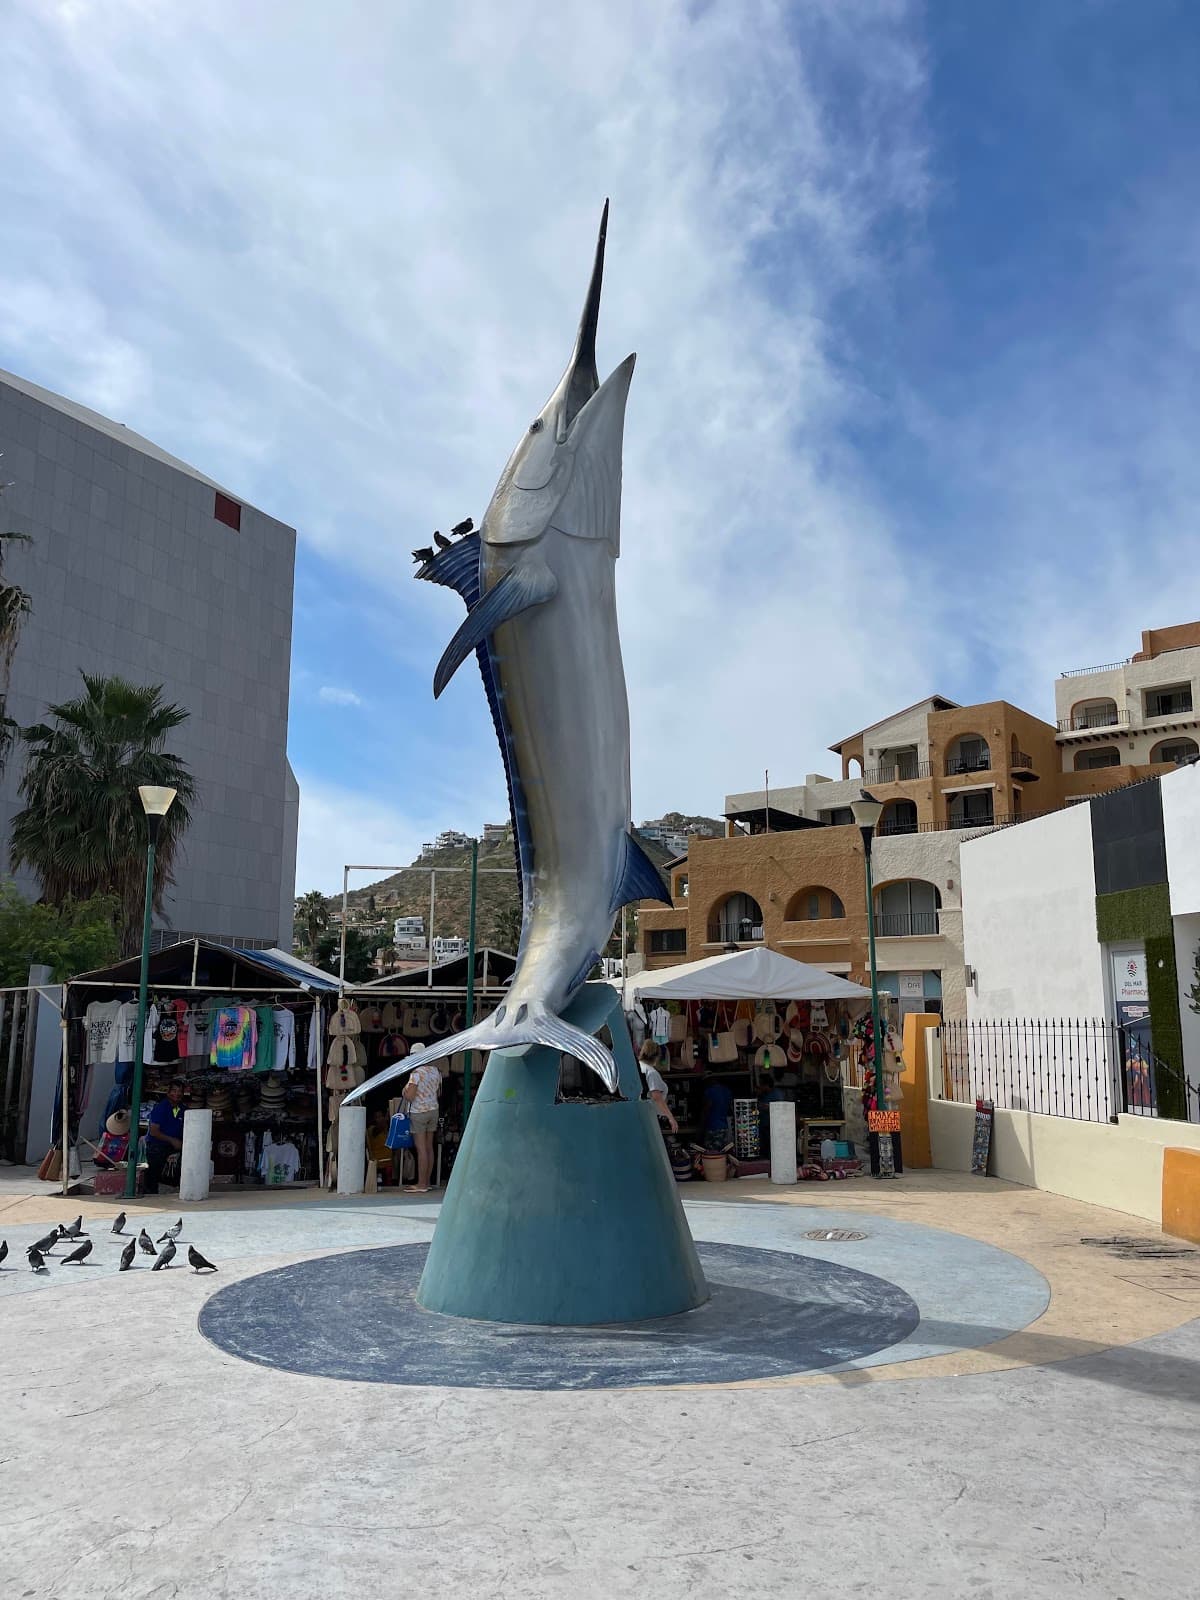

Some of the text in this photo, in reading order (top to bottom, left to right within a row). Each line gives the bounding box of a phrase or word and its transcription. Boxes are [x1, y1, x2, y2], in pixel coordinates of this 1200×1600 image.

[1121, 988, 1147, 997] Pharmacy
[91, 1020, 113, 1028] KEEP
[874, 1111, 898, 1119] MAKE
